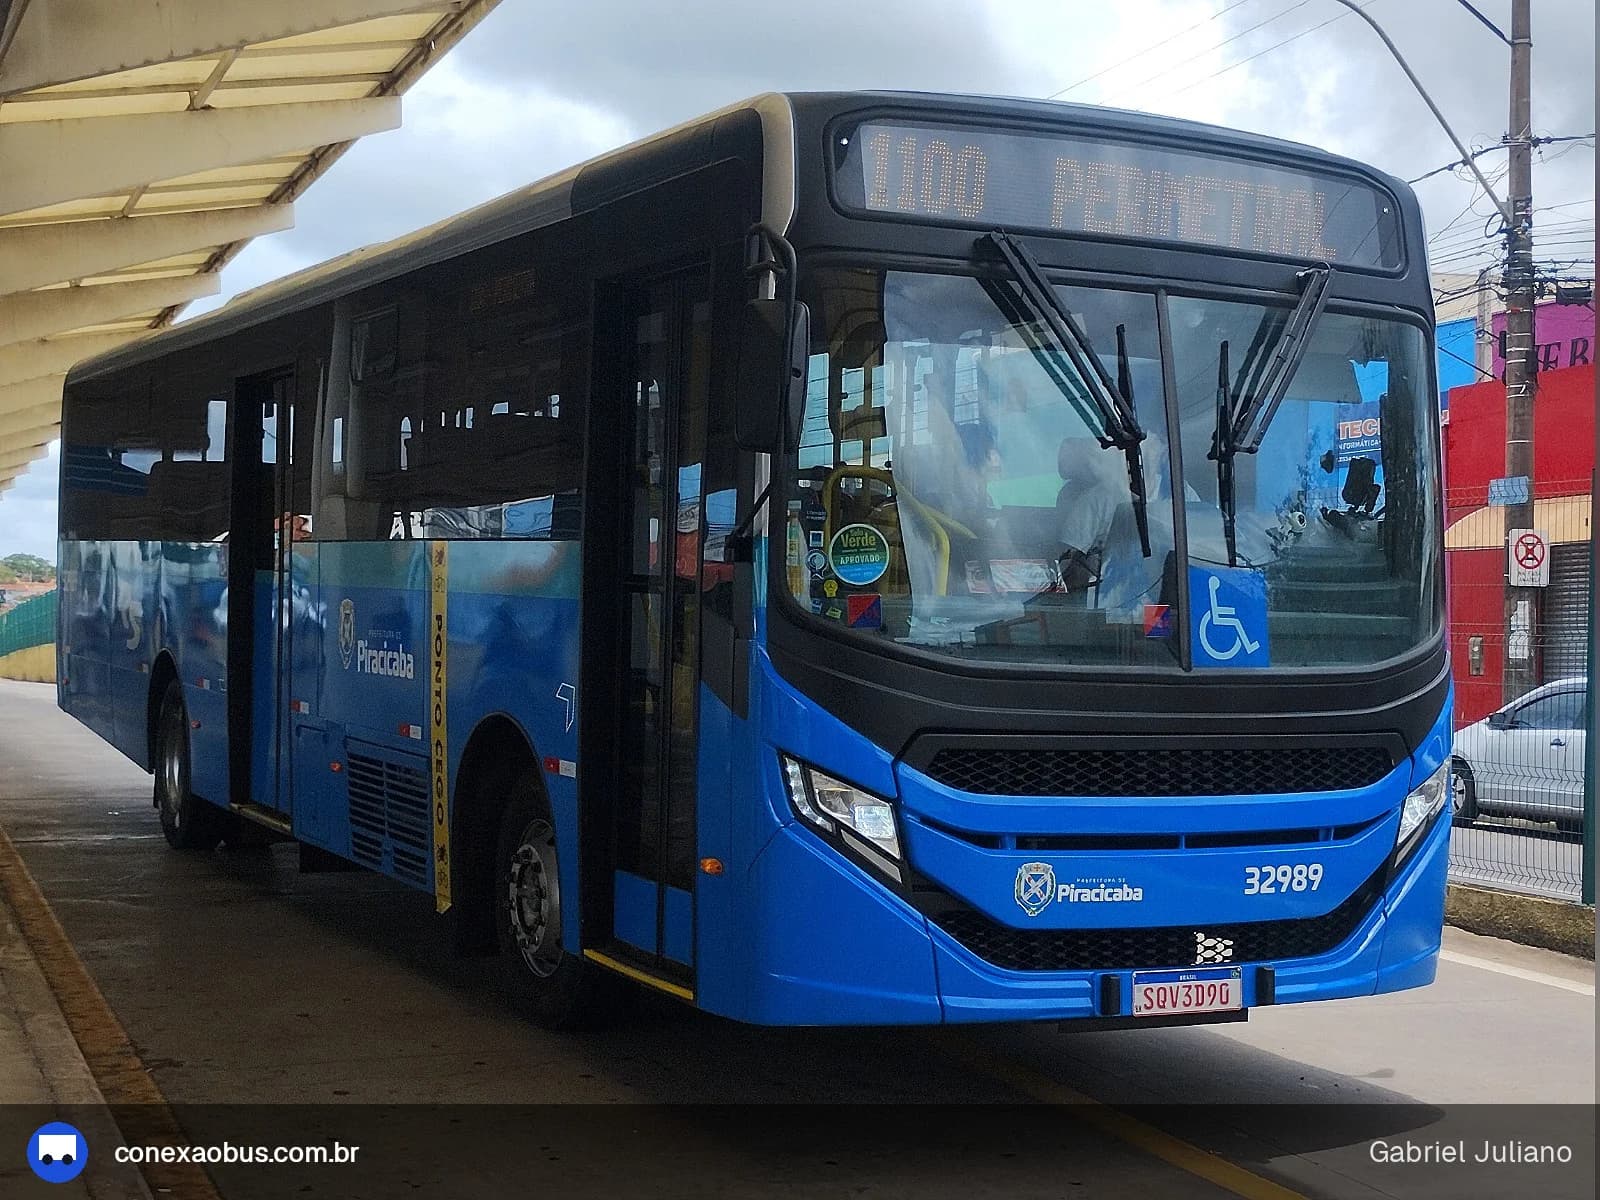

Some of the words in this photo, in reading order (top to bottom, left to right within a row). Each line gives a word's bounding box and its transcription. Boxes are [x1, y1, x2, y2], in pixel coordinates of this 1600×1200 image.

[869, 132, 987, 217] 1100
[1051, 156, 1337, 261] PERIMETRAL
[1339, 418, 1381, 440] TEC
[840, 532, 876, 548] Verde
[840, 554, 880, 565] APROVADO
[357, 640, 414, 680] Piracicaba
[434, 614, 444, 728] PONTO
[435, 738, 445, 827] CEGO
[1057, 883, 1143, 903] Piracicaba
[1244, 863, 1324, 895] 32989
[1143, 982, 1230, 1011] SQV3D90
